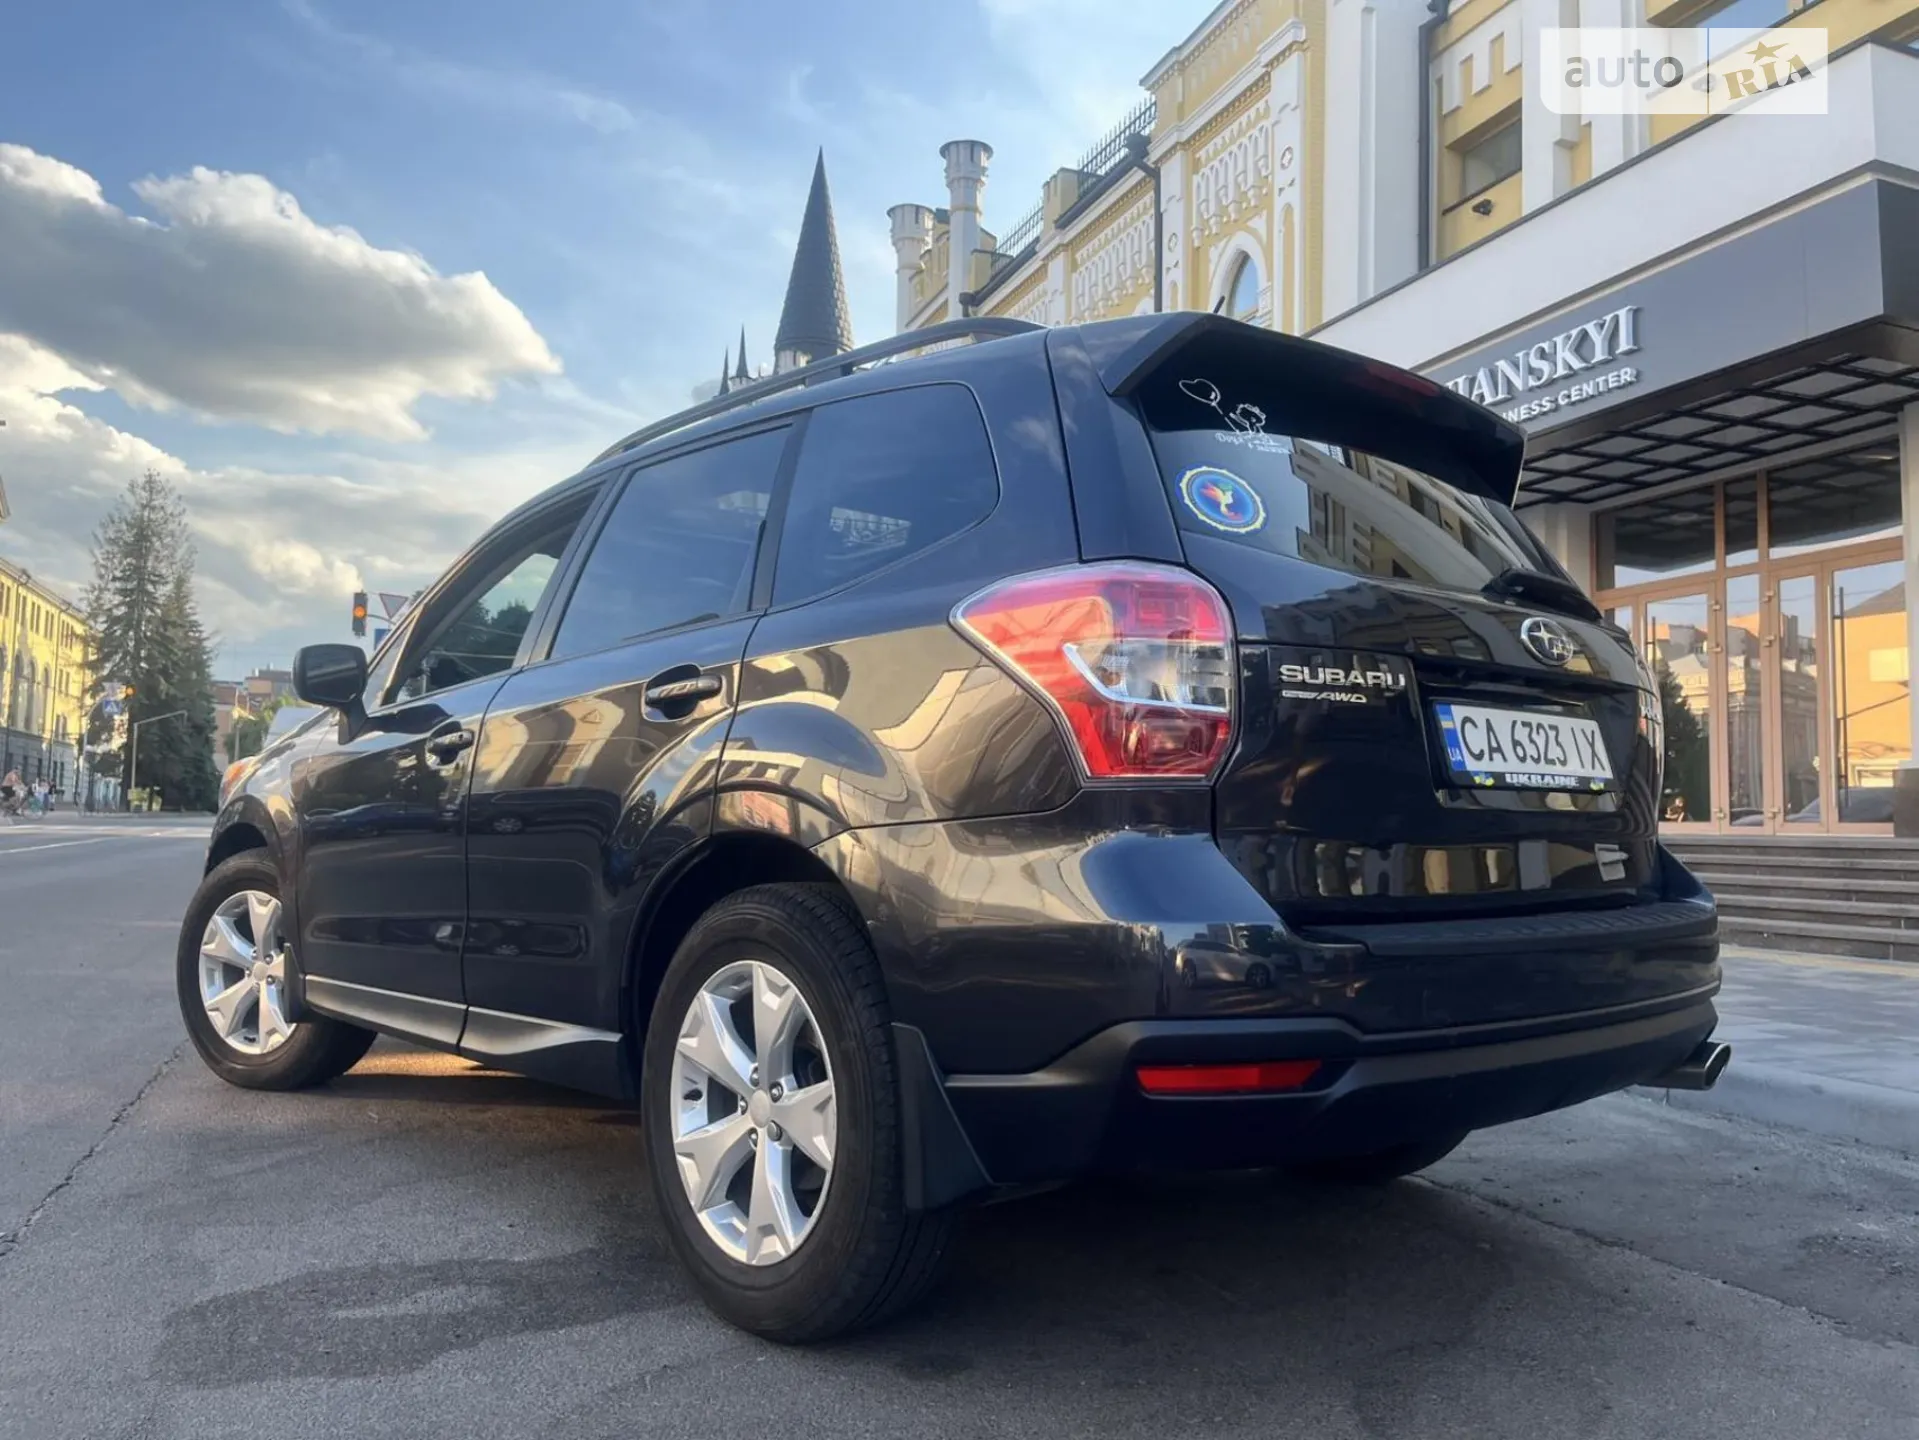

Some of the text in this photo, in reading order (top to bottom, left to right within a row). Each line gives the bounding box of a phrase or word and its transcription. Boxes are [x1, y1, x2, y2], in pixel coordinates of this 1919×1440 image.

[1445, 305, 1642, 406] IANSKYI
[1557, 367, 1641, 405] CENTER
[1279, 664, 1406, 690] SUBARU
[1316, 691, 1367, 703] AWD
[1448, 747, 1463, 762] UA
[1460, 716, 1606, 772] CA 6323 IX
[1505, 773, 1580, 787] UKRAINE
